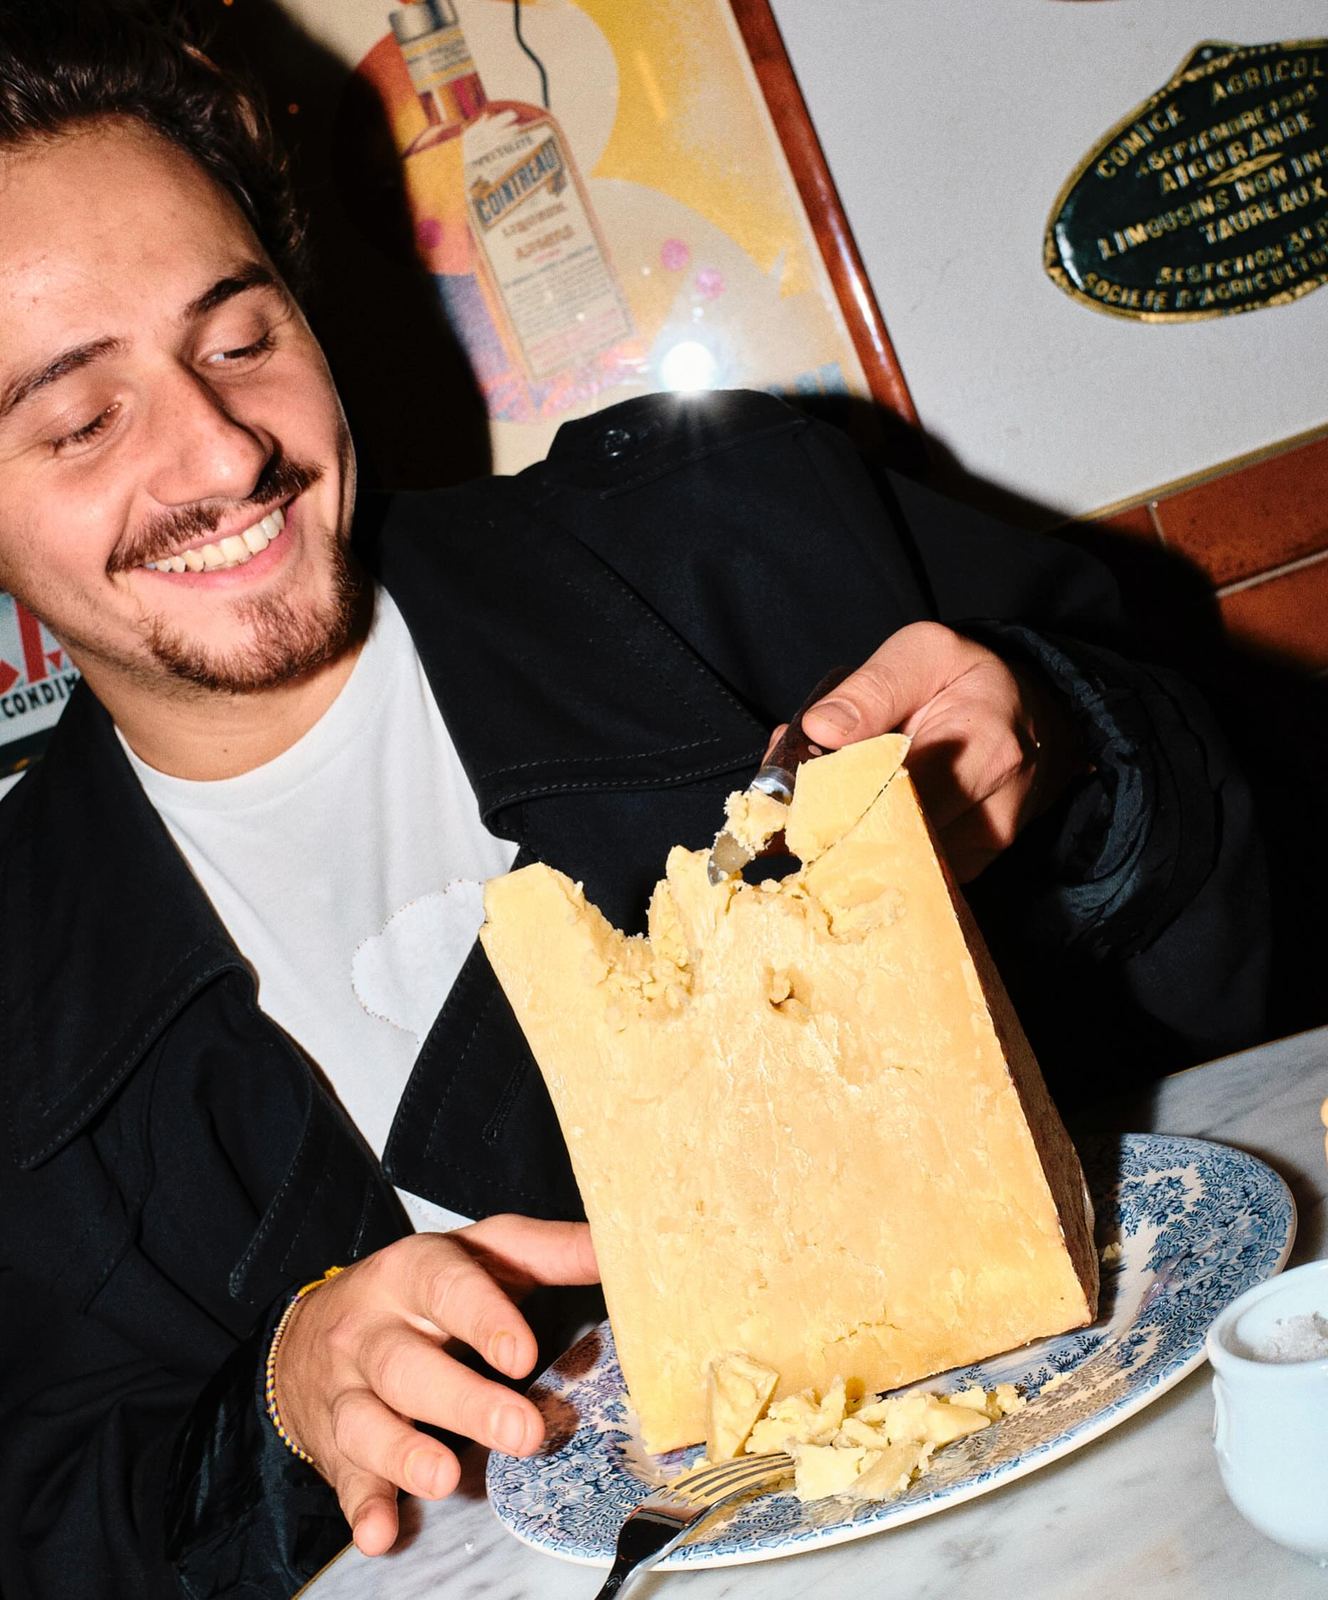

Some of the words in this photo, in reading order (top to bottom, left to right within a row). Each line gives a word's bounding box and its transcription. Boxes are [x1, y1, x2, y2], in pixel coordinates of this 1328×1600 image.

[1096, 103, 1184, 179] COMICE
[1211, 57, 1325, 103] AGRICOL
[1160, 110, 1315, 194] AIGURANDE
[1097, 189, 1231, 260] LIMOUSINS
[1235, 165, 1288, 201] NON
[1203, 177, 1328, 244] TAUREAUX
[1176, 243, 1328, 307] D'AGRICULTU
